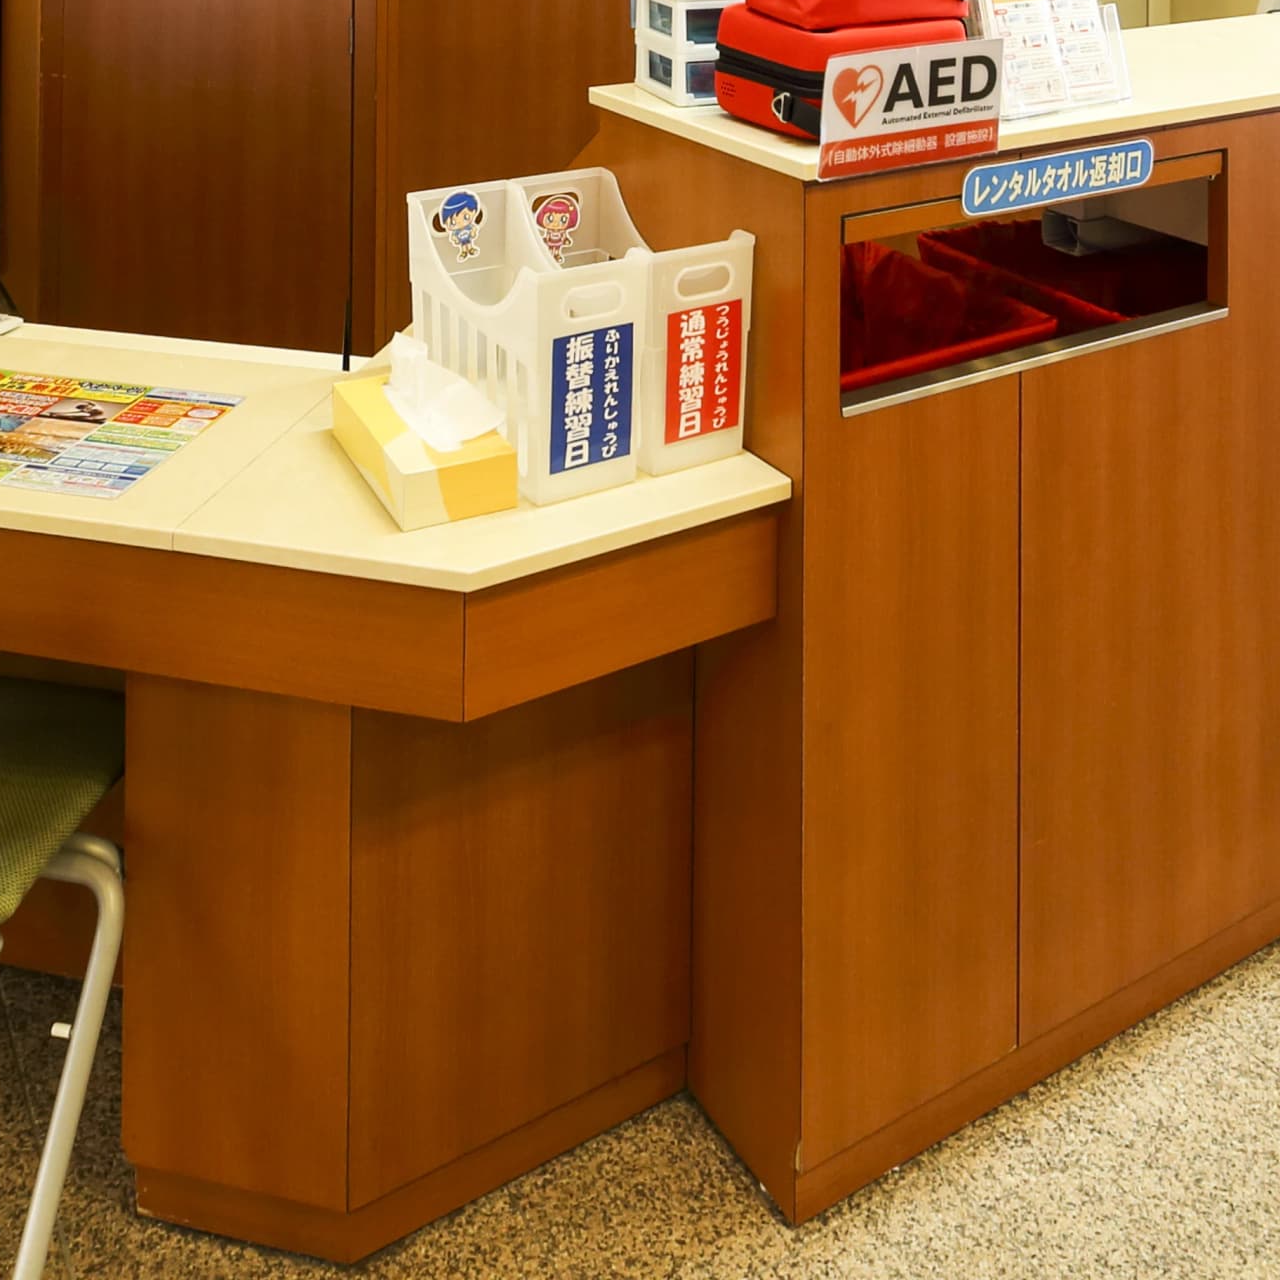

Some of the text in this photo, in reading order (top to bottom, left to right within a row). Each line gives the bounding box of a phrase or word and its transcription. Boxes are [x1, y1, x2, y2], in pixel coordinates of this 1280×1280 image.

[881, 104, 995, 126] Automated External Defibrillator
[882, 55, 997, 113] AED
[973, 147, 1144, 206] レンタルタオル返却口
[563, 331, 595, 470] 振替練習日
[601, 327, 621, 460] ふりかえれんしゅうび
[678, 308, 706, 440] 通常練習日
[713, 304, 730, 430] つうじょうれんしゅうび
